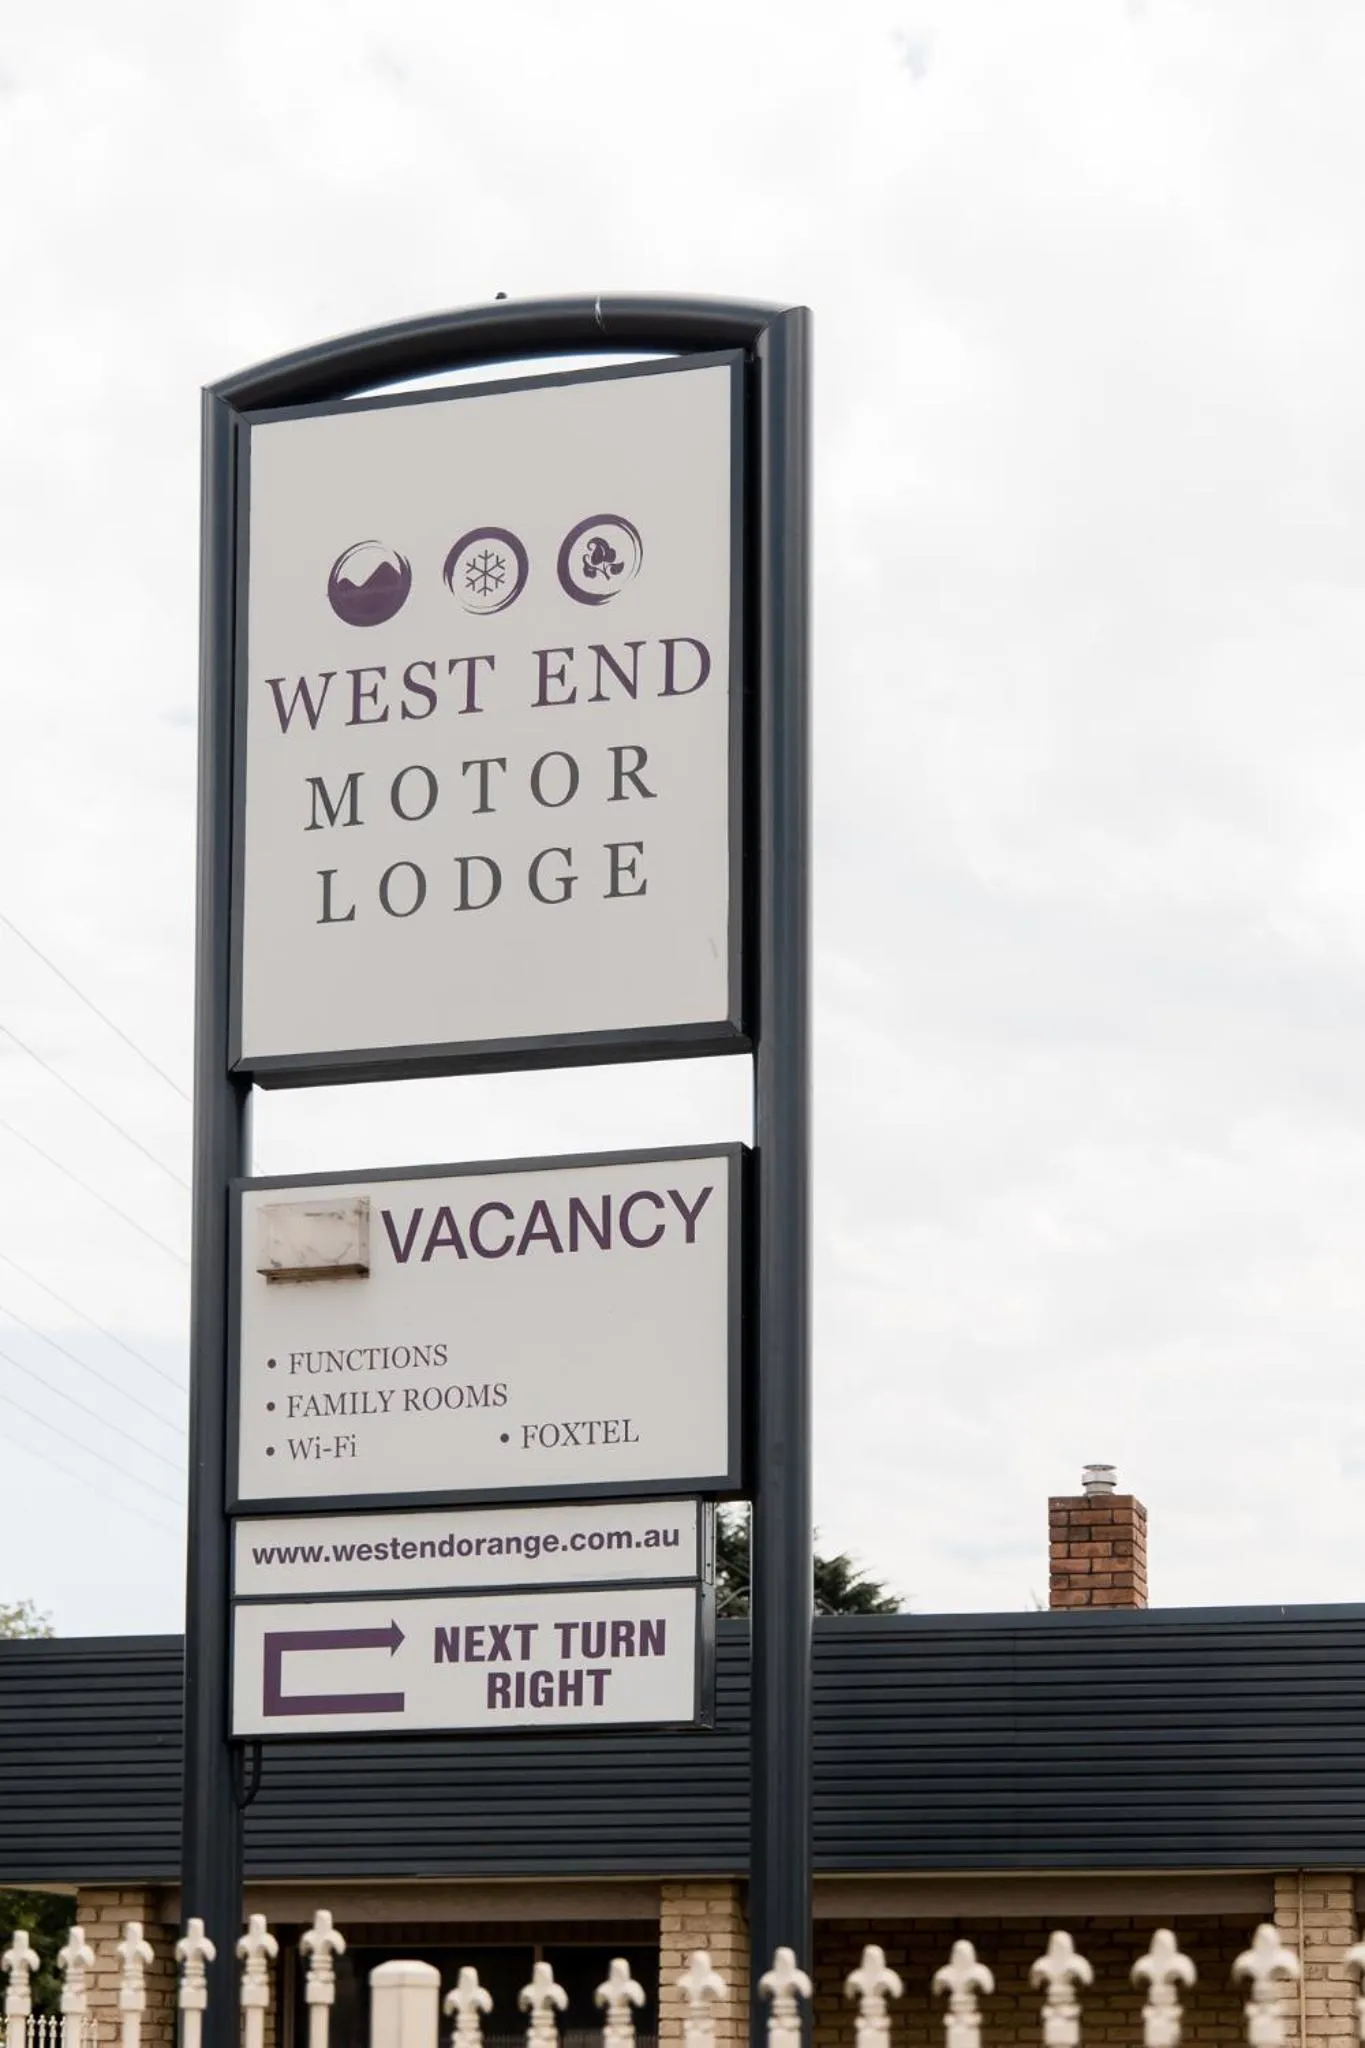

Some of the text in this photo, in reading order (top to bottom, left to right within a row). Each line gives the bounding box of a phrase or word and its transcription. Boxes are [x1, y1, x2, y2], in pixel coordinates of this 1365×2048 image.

[264, 636, 712, 734] WEST END
[303, 744, 658, 831] MOTOR
[316, 840, 649, 925] LODGE
[380, 1186, 715, 1264] VACANCY
[289, 1343, 448, 1375] FUNCTIONS
[287, 1383, 508, 1418] FAMILY ROOMS
[287, 1433, 357, 1461] Wi-Fi
[522, 1419, 640, 1449] FOXTEL
[251, 1528, 681, 1565] www.westendorange.com.au
[433, 1618, 667, 1664] NEXT TURN
[486, 1668, 613, 1710] RIGHT
